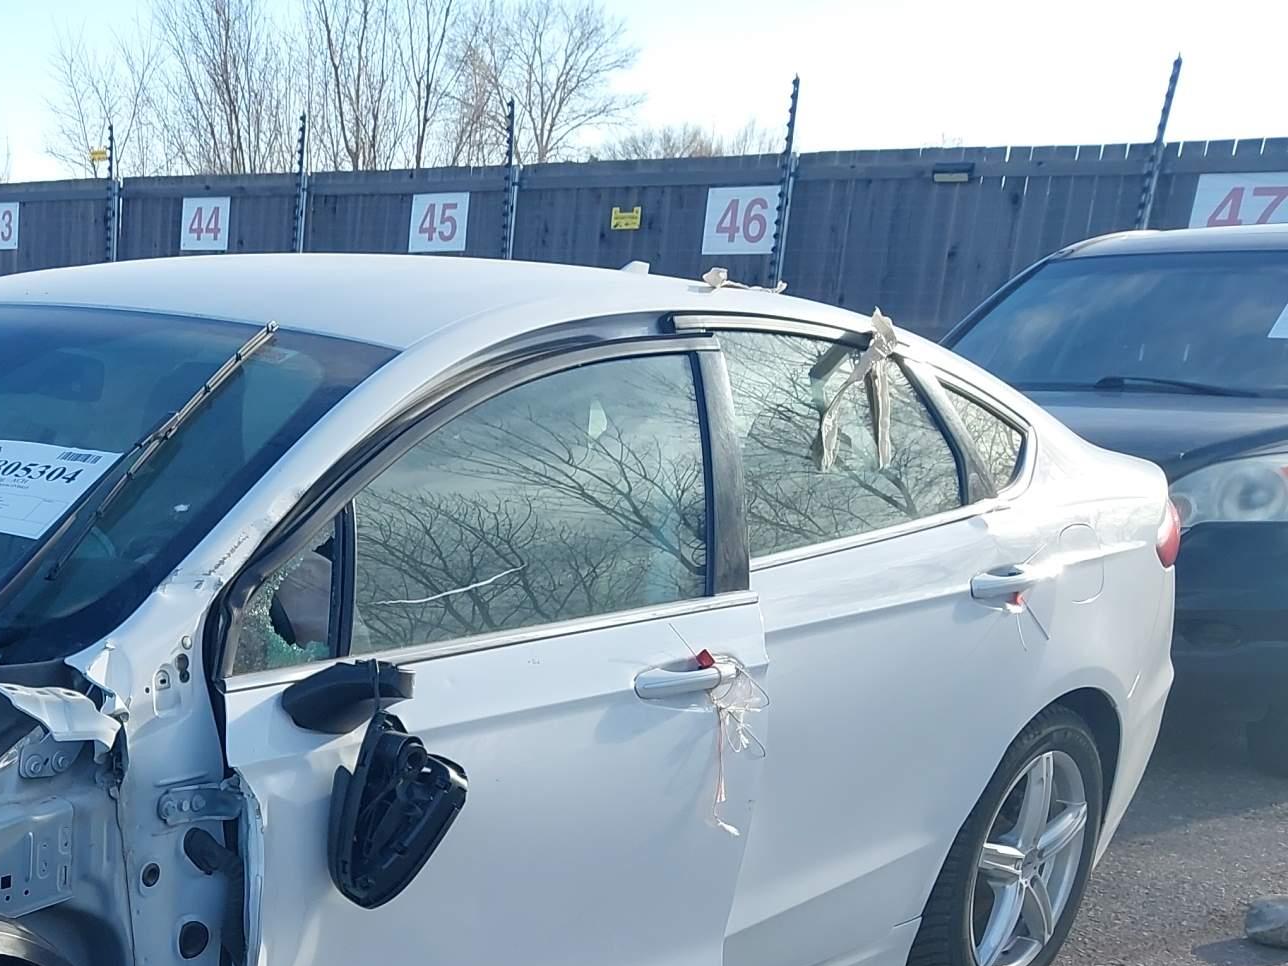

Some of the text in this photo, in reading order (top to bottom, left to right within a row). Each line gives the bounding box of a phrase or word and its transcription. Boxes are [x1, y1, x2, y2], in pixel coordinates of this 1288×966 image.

[188, 207, 221, 241] 44
[417, 202, 459, 242] 45
[715, 197, 769, 243] 46
[1206, 186, 1288, 228] 47
